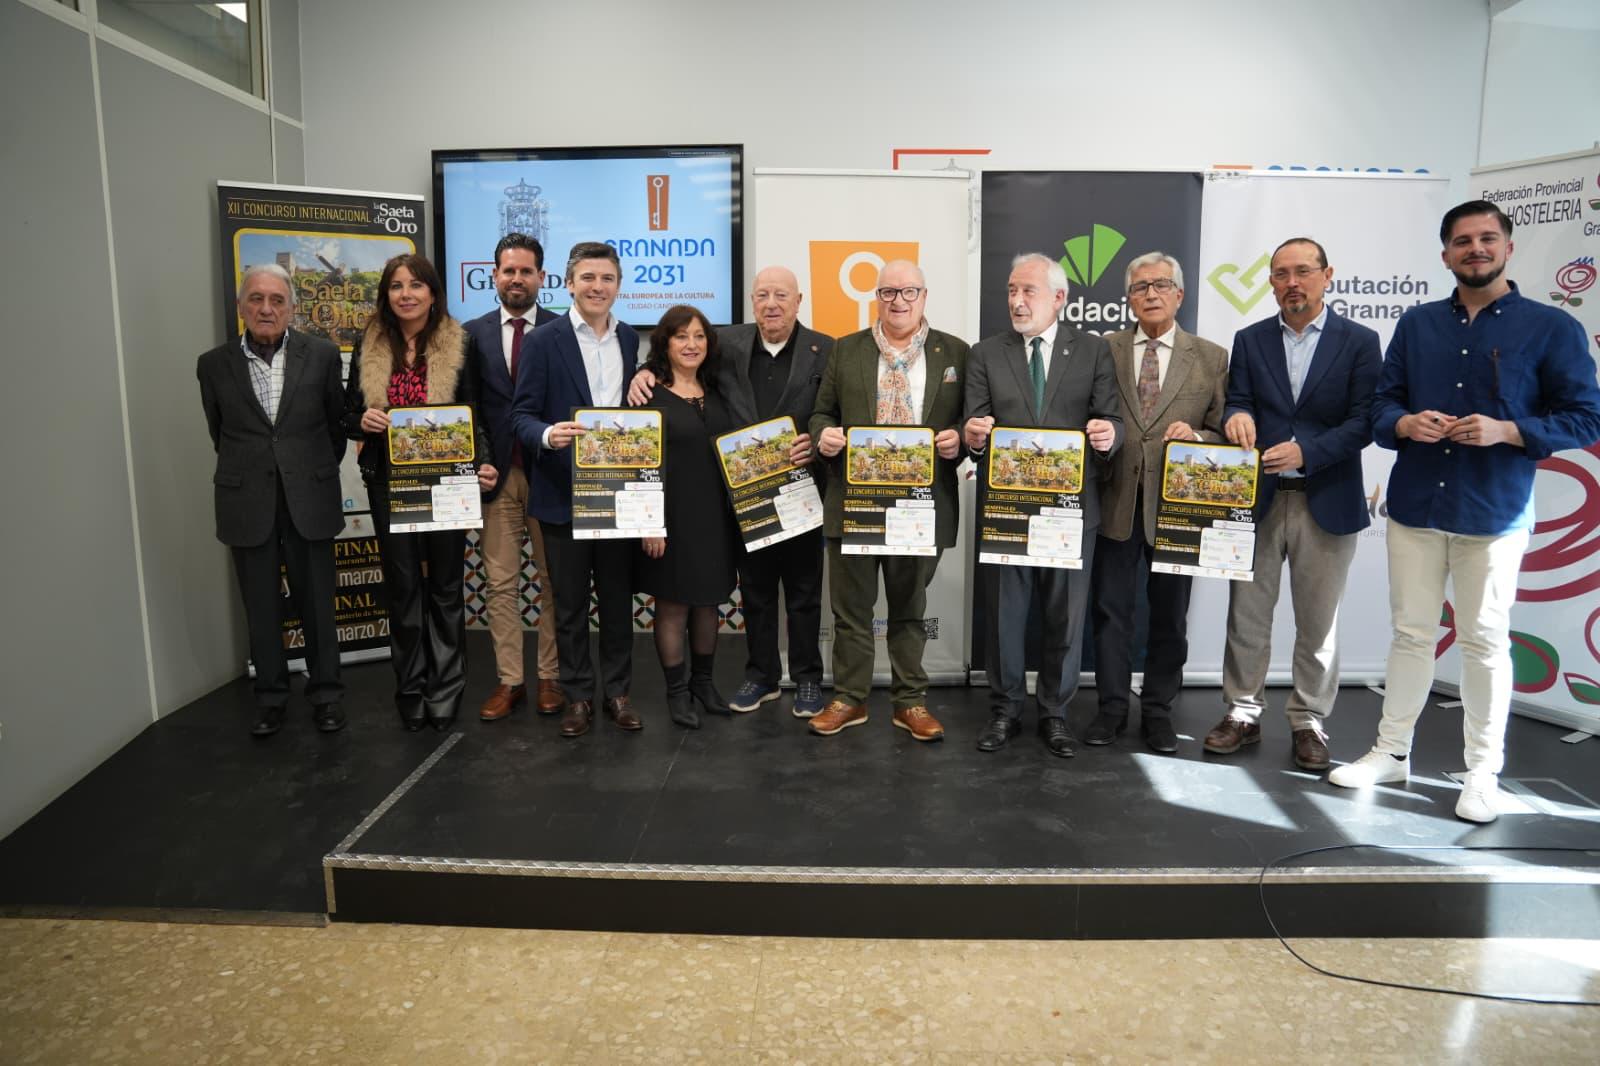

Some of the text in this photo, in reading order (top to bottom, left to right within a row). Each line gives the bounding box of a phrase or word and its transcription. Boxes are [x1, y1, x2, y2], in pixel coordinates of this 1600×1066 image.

[1482, 177, 1584, 202] Federación Provincial
[227, 201, 371, 223] XII CONCURSO INTERNACIONAL
[379, 203, 415, 218] Saeta
[1507, 198, 1582, 226] HOSTELERIA
[374, 215, 418, 234] de Oro
[634, 265, 685, 286] 2031
[300, 278, 365, 301] Saeta
[1063, 501, 1080, 509] Oro
[1236, 515, 1253, 523] Oro
[340, 569, 383, 587] marzo
[335, 592, 377, 611] INAL
[288, 628, 306, 648] 23
